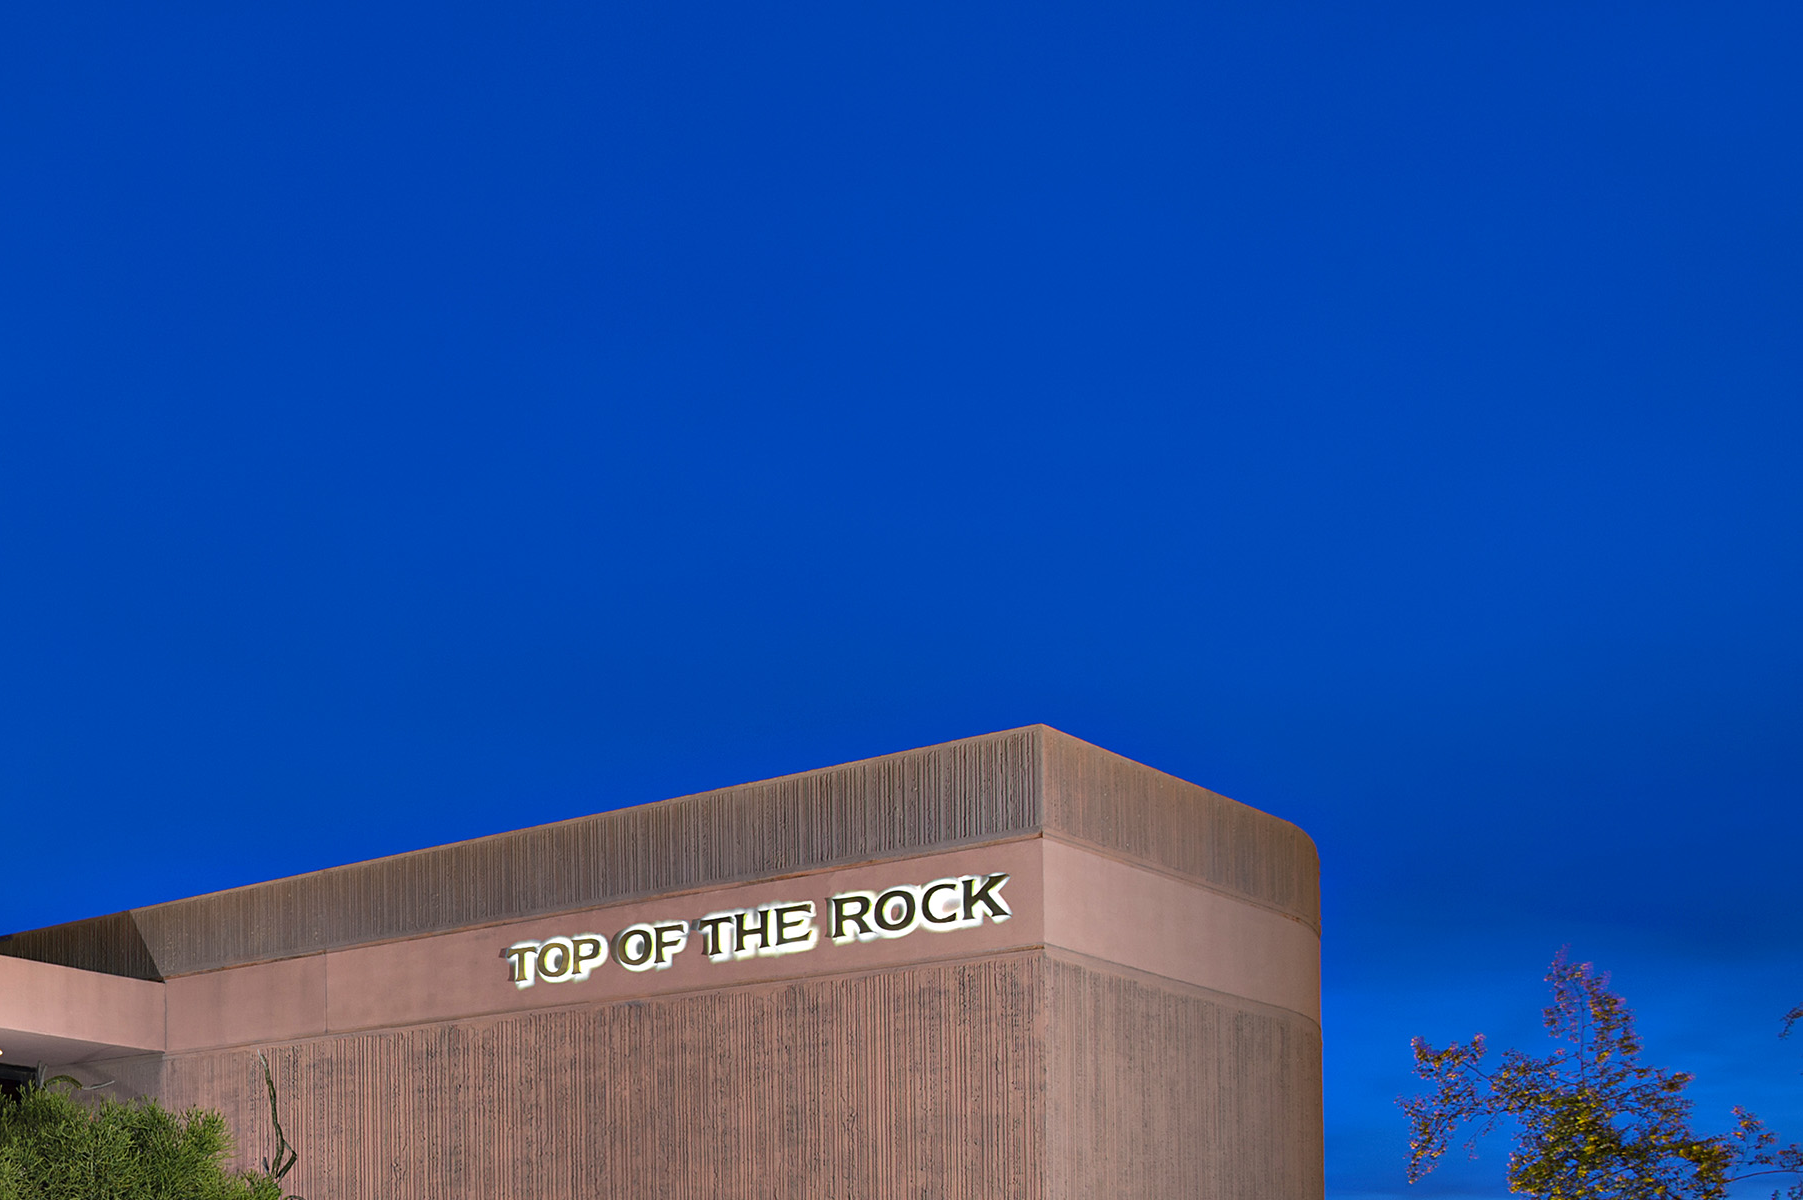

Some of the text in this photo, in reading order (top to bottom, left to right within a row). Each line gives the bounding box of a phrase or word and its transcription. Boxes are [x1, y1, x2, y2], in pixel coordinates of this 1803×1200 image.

[505, 872, 1013, 984] TOP OF THE ROCK
